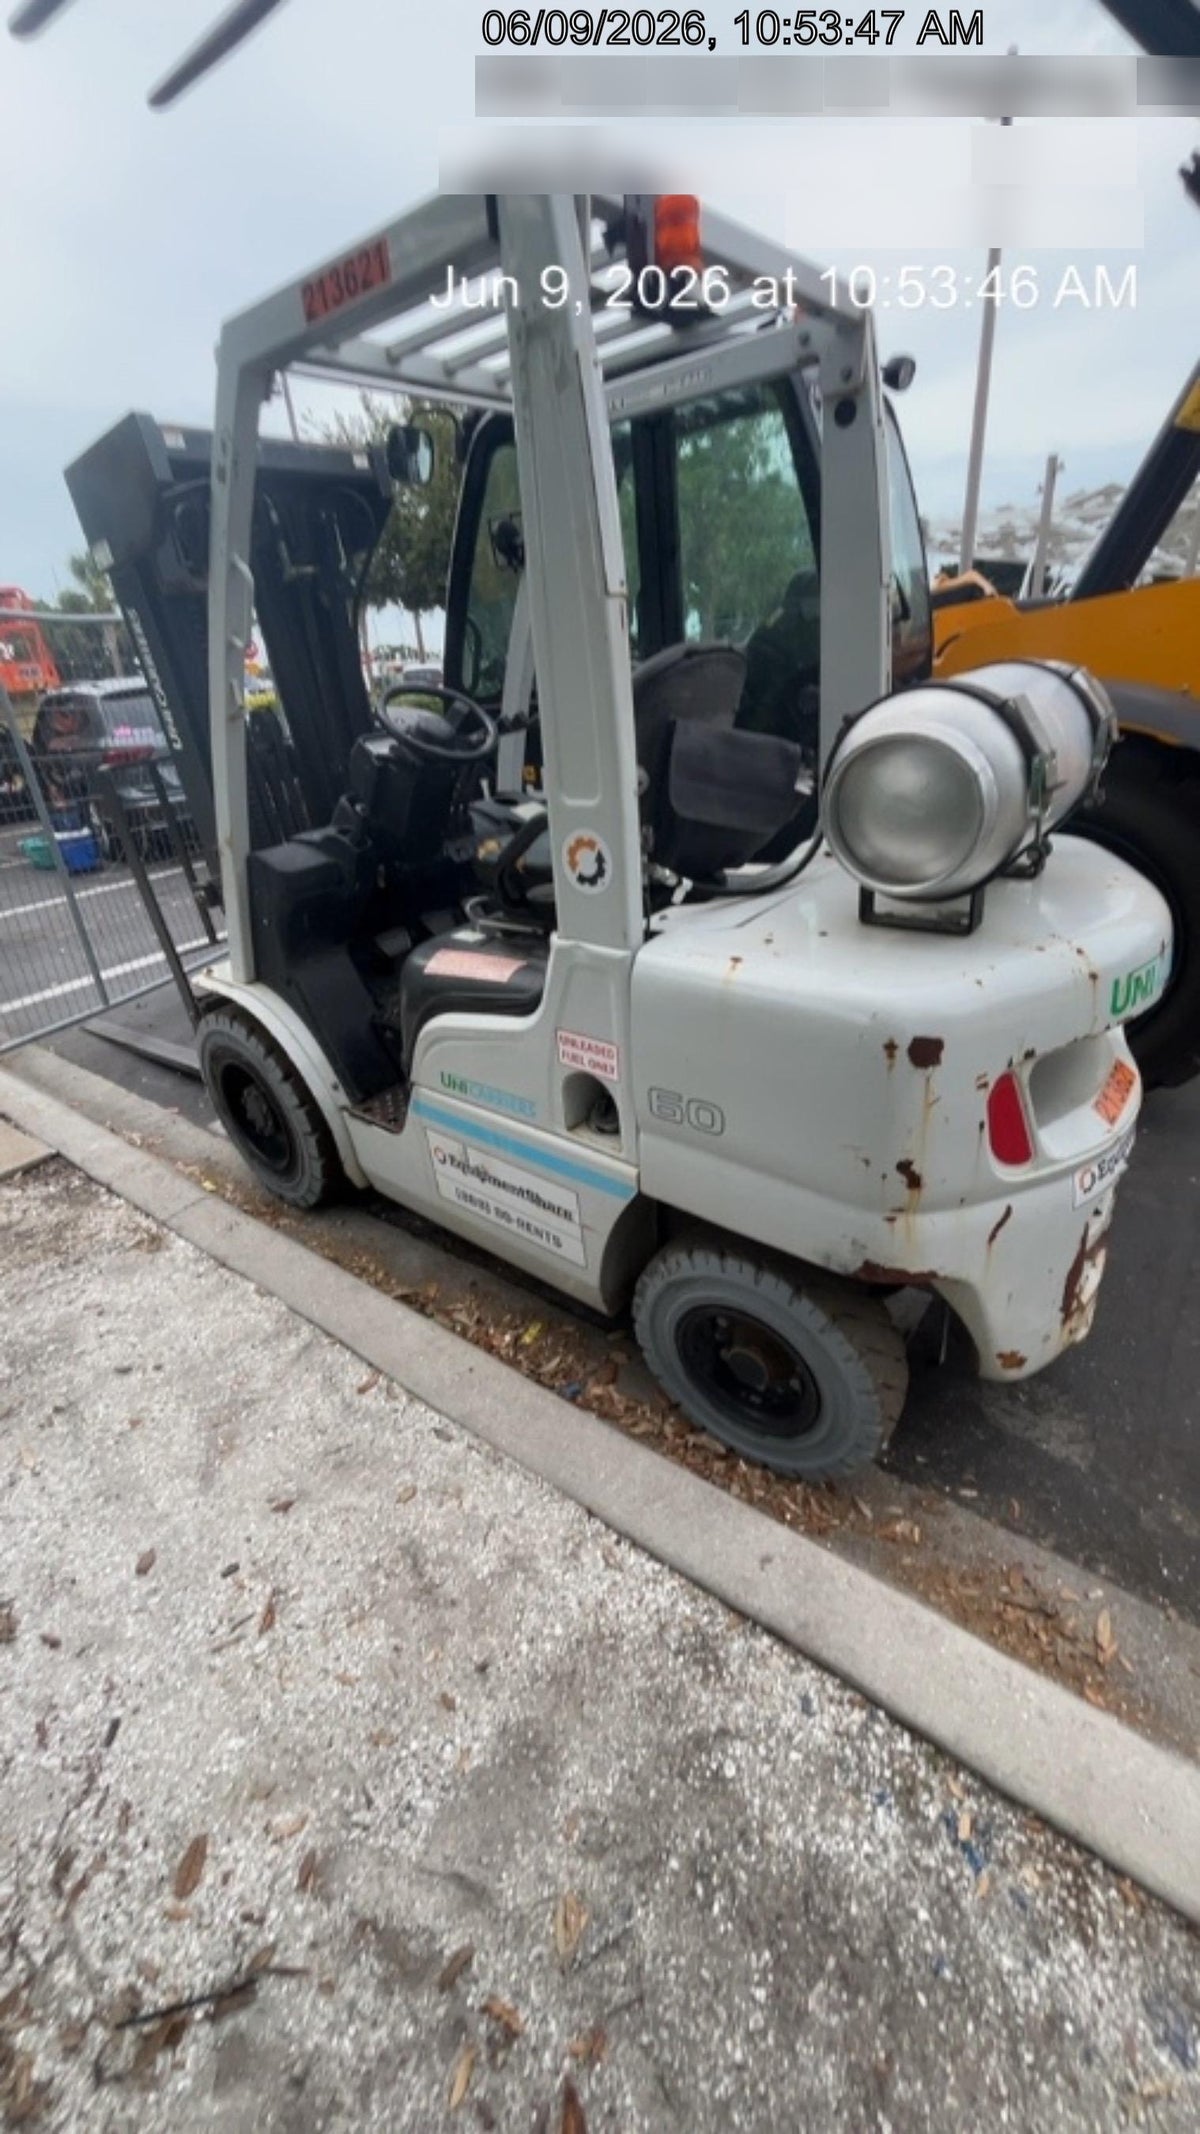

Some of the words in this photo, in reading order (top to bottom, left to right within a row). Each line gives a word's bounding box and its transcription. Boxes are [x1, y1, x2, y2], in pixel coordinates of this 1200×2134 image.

[301, 239, 388, 322] 213621
[558, 1033, 615, 1061] UNLEADED
[561, 1048, 585, 1066] FUEL
[587, 1056, 616, 1076] ONLY
[648, 1085, 727, 1137] 60
[448, 1152, 574, 1222] EquipmentShare
